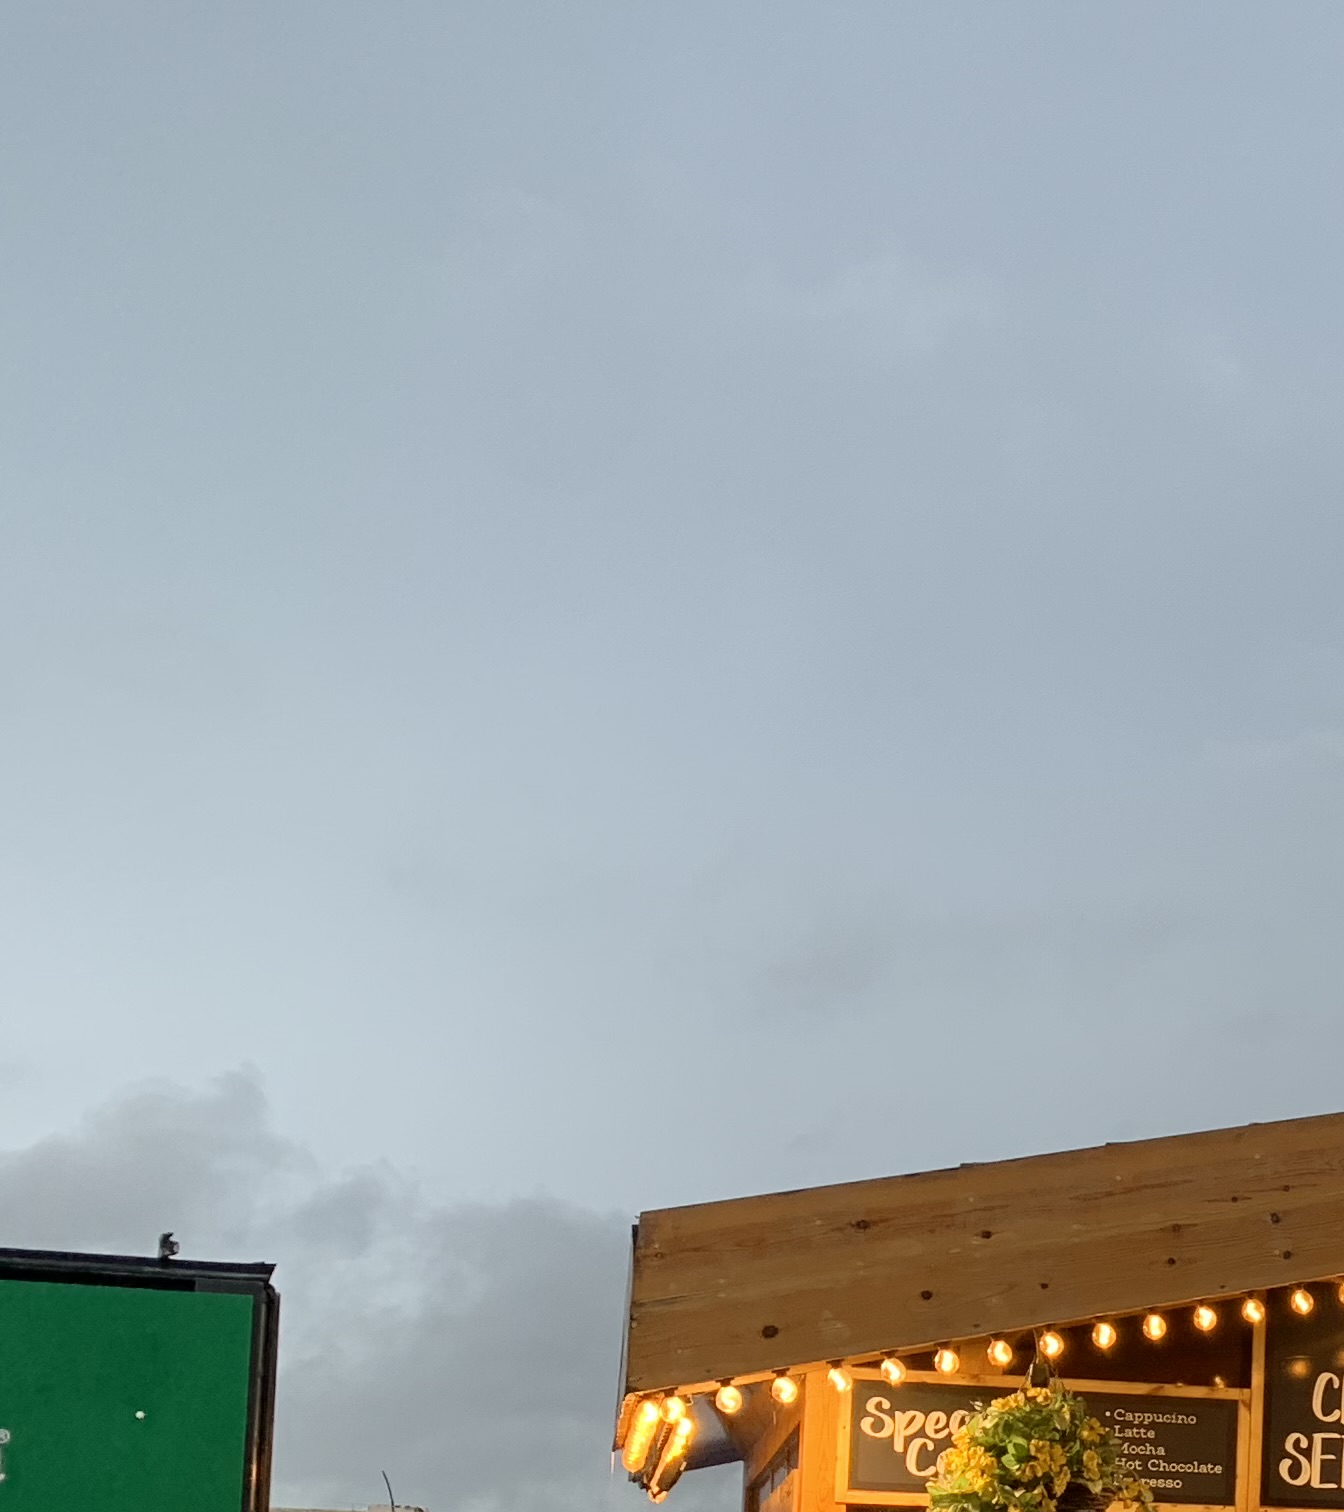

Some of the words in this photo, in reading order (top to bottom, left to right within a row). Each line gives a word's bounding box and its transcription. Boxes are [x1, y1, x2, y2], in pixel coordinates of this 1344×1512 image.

[1113, 1408, 1197, 1425] Cappucino
[1114, 1425, 1156, 1439] Latte
[1147, 1459, 1223, 1474] Chocolate
